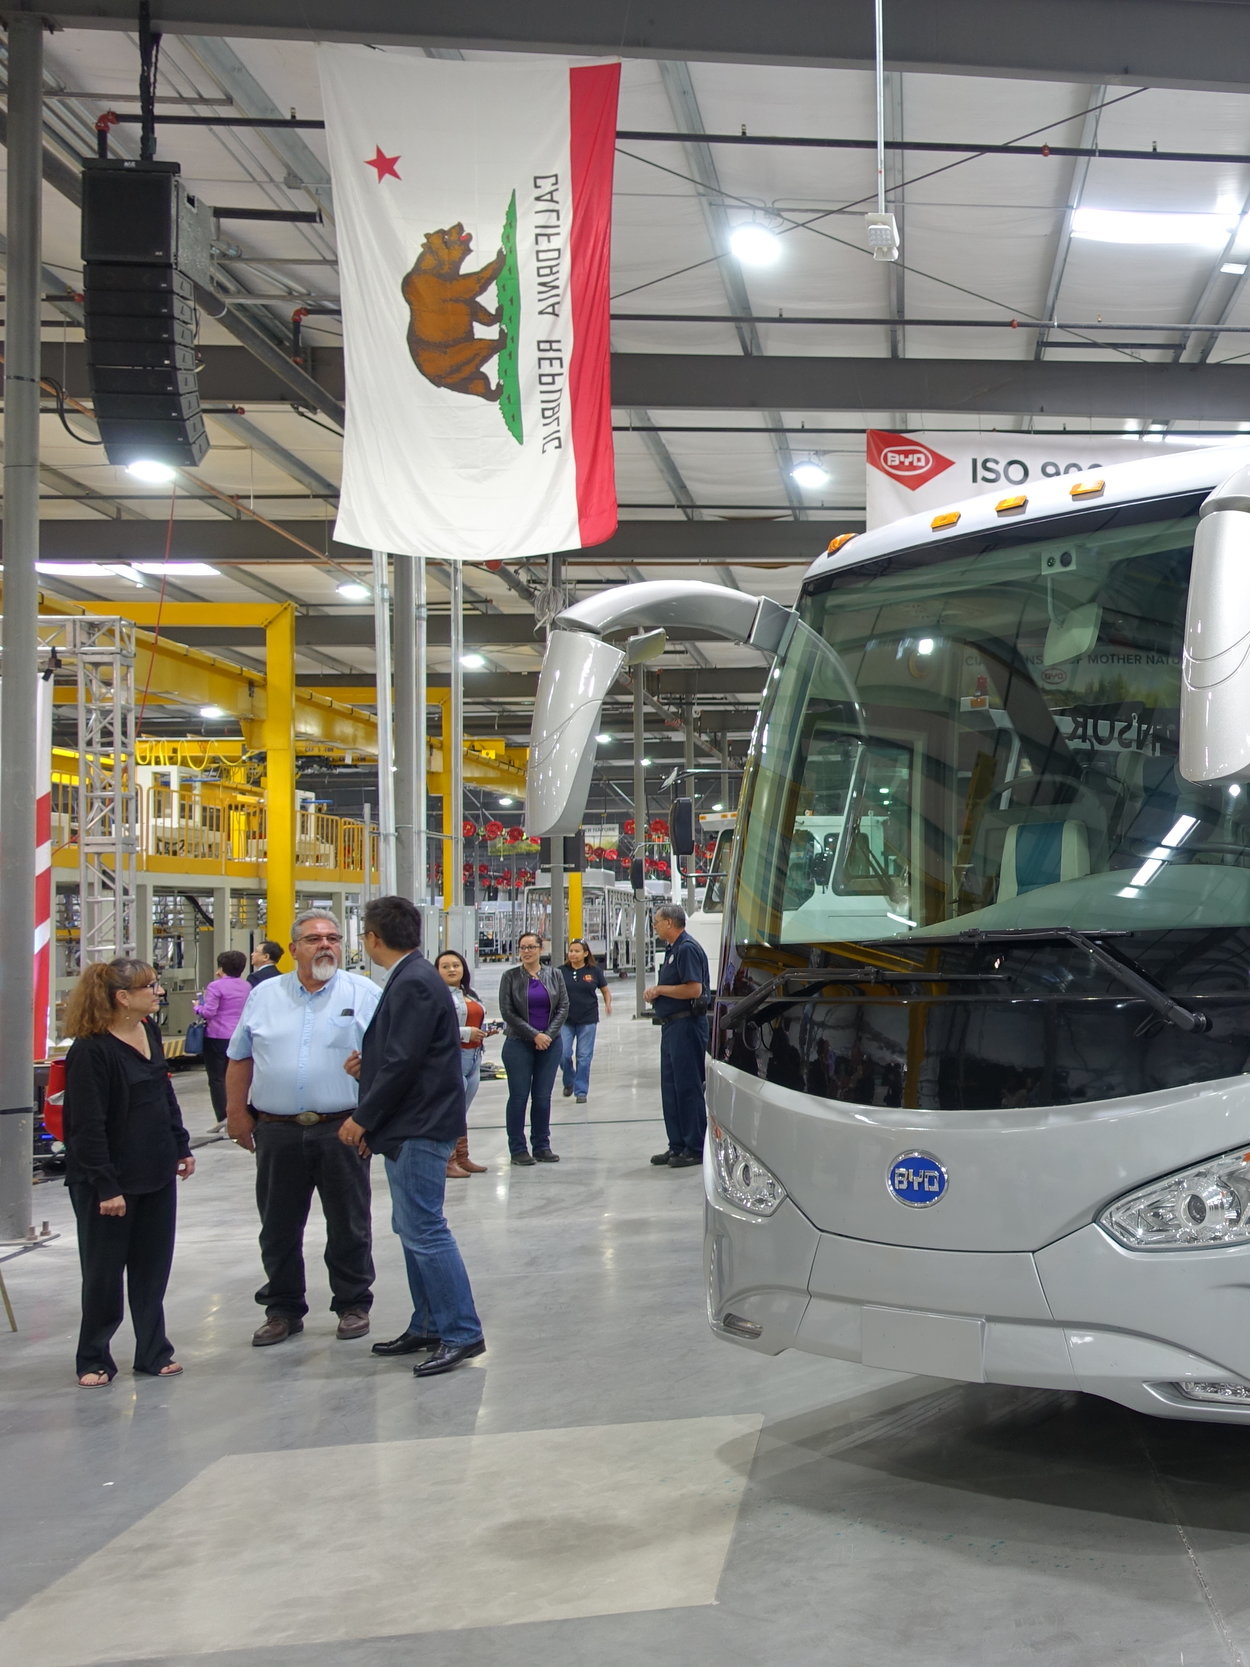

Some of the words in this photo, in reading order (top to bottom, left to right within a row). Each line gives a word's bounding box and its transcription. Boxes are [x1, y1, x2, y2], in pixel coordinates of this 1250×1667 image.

[887, 451, 926, 467] BYD
[971, 457, 1030, 485] ISO
[1087, 654, 1142, 665] MOTHER
[1146, 653, 1181, 665] NATU
[894, 1168, 939, 1192] BYD
